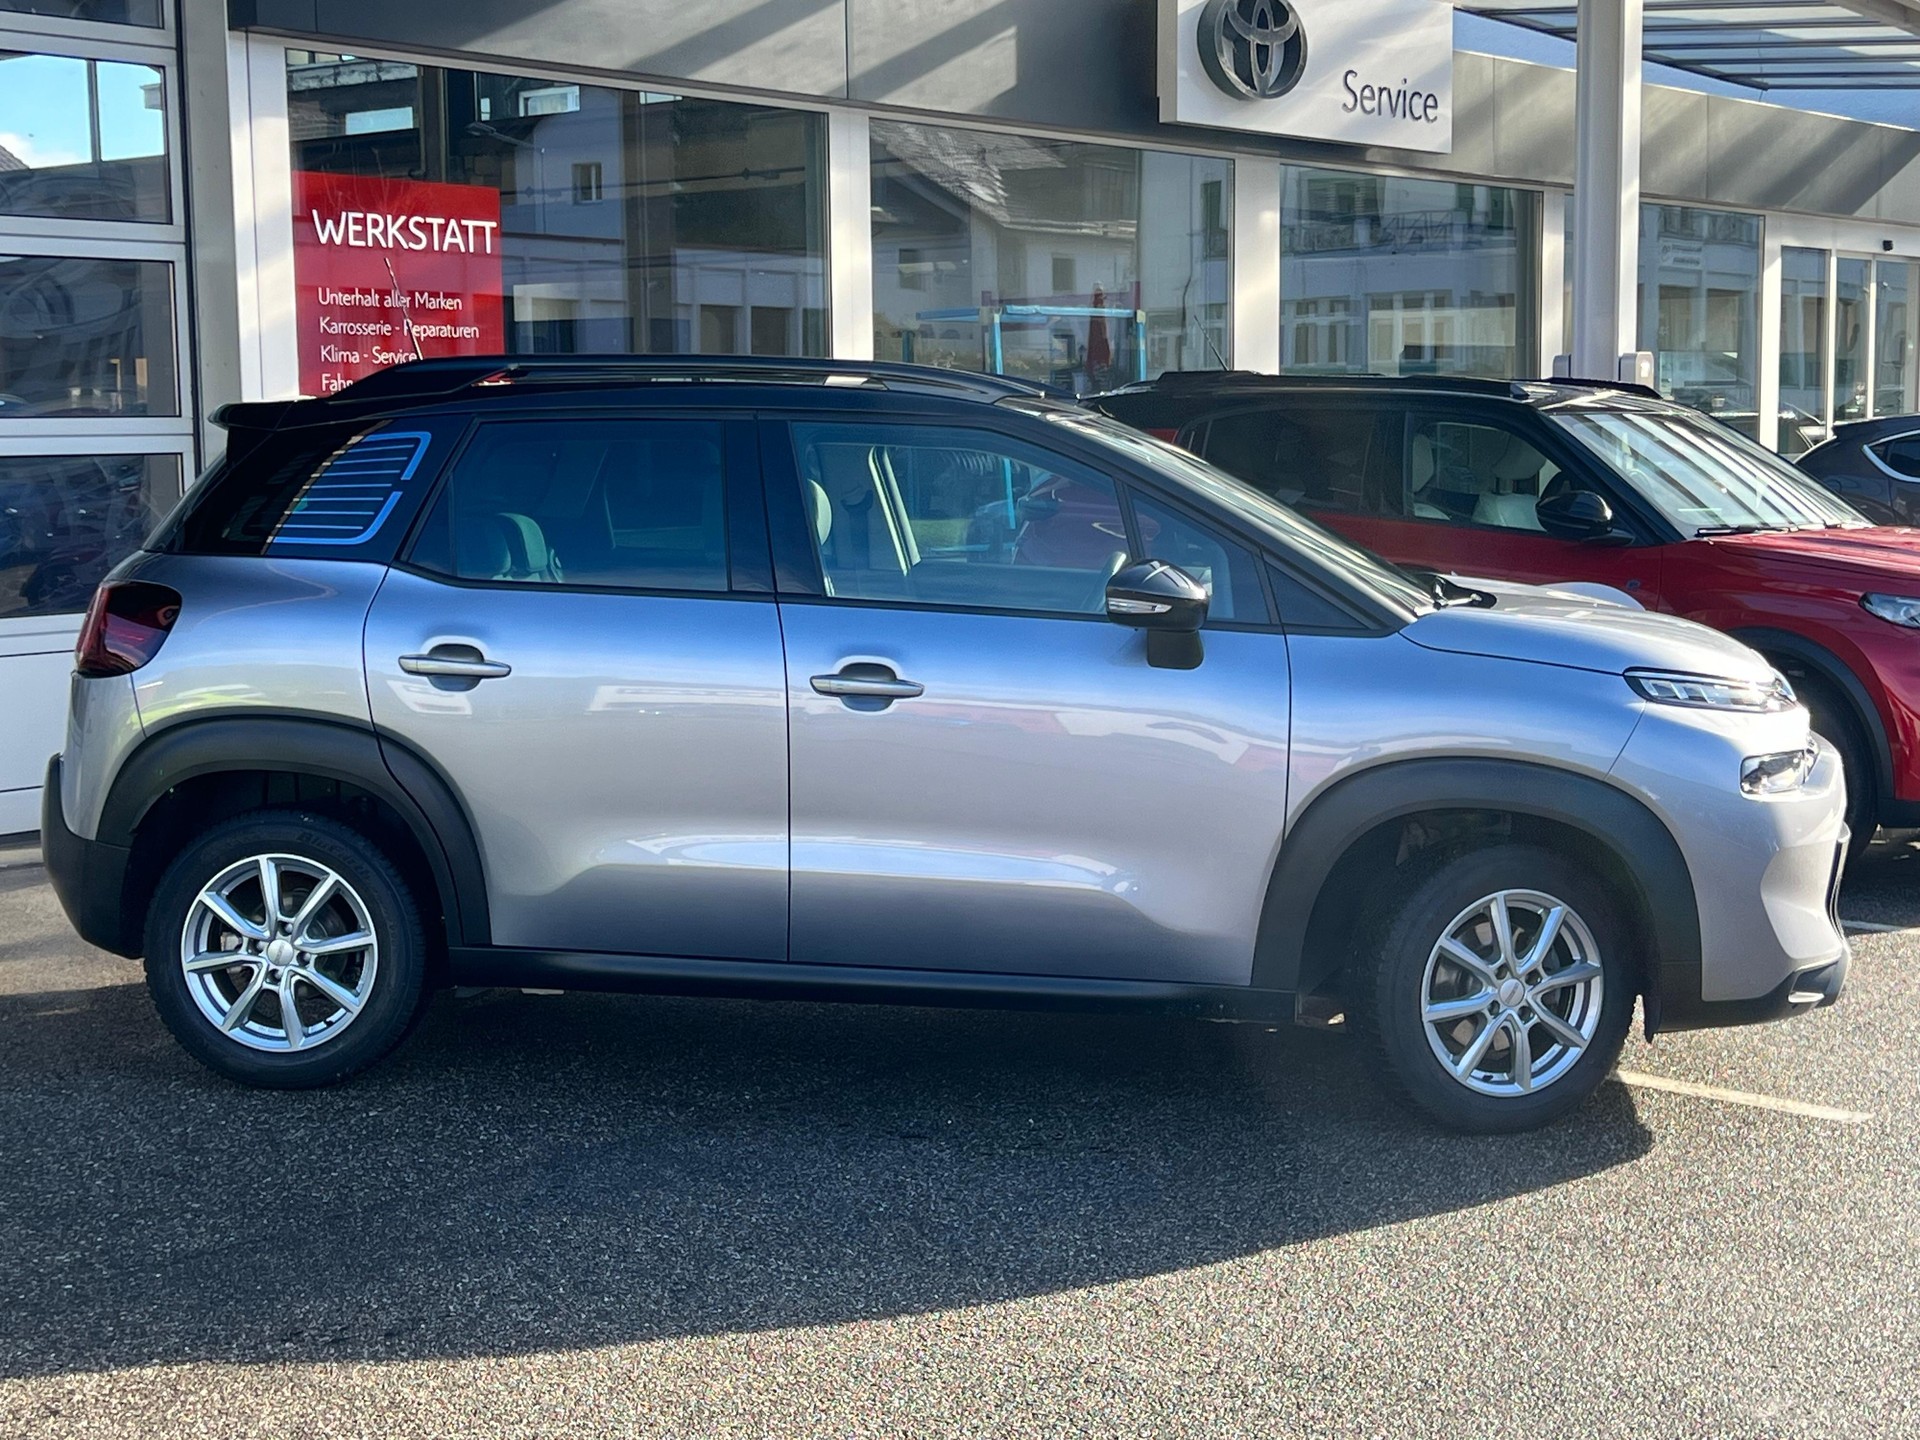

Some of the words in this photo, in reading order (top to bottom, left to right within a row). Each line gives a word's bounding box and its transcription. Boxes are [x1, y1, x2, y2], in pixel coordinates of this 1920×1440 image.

[1342, 69, 1439, 124] Service
[312, 209, 497, 254] WERKSTATT
[318, 287, 380, 307] Unterhalt
[384, 289, 411, 307] aller
[415, 292, 462, 311] Marken
[319, 317, 392, 336] Karrosserie
[320, 346, 360, 363] Klima
[372, 346, 417, 365] Service
